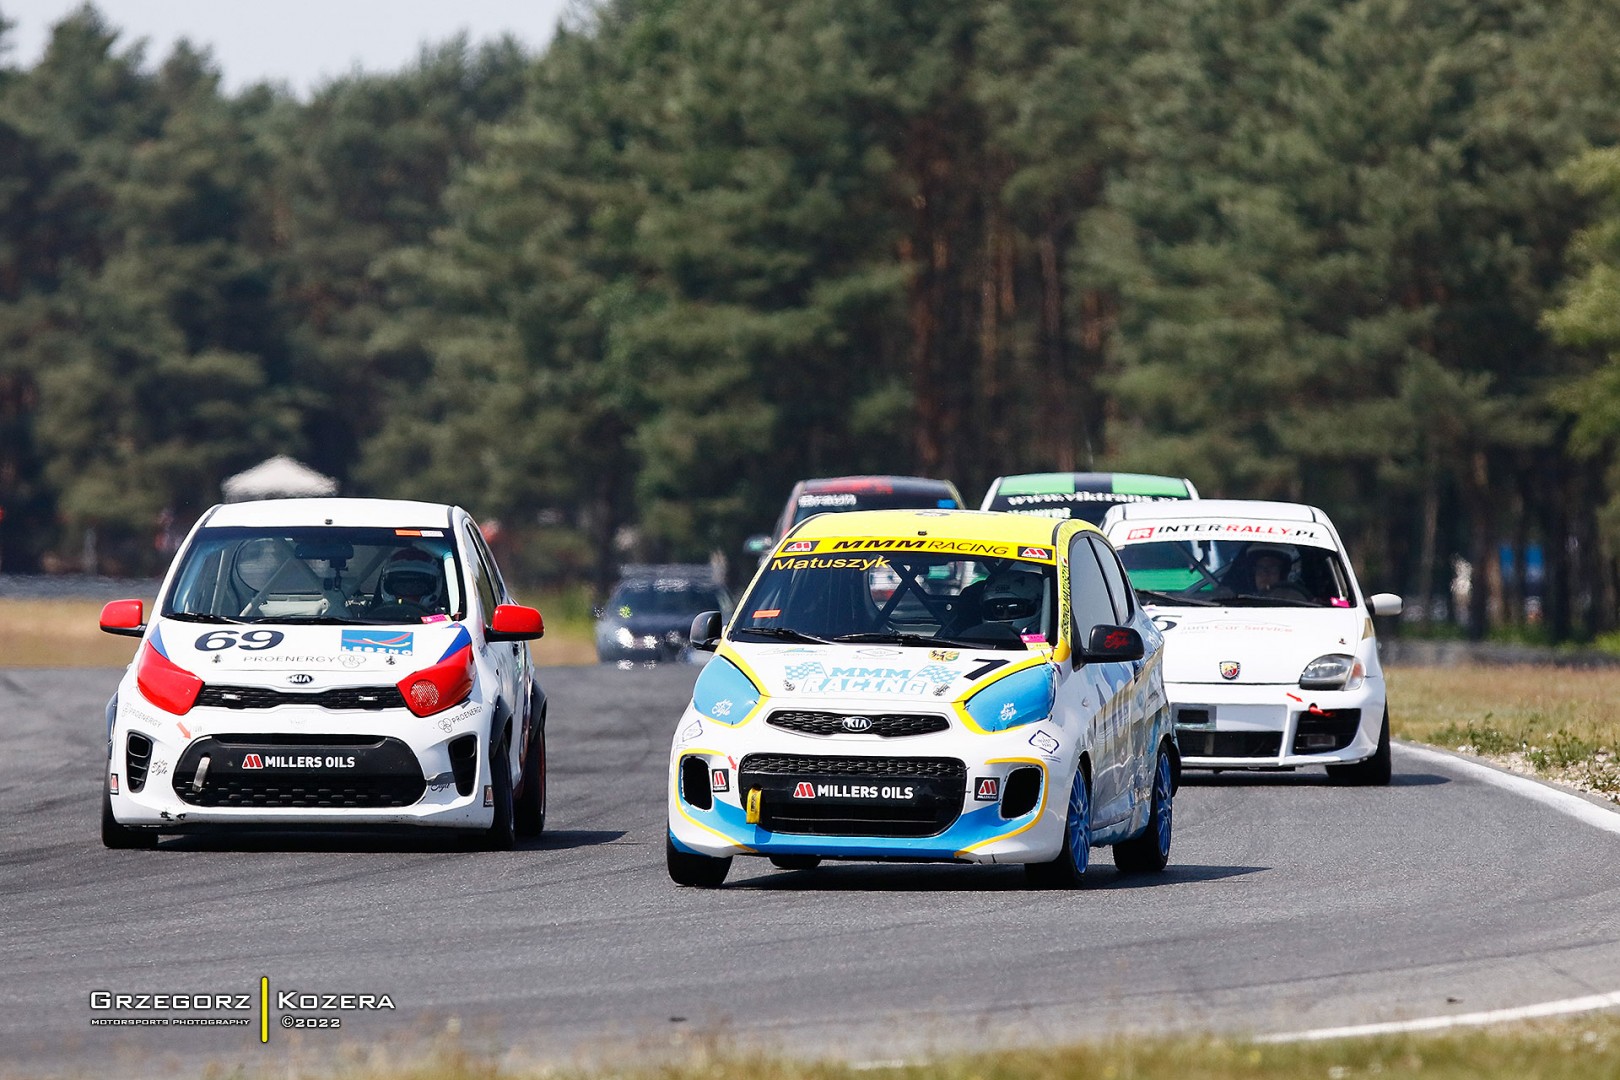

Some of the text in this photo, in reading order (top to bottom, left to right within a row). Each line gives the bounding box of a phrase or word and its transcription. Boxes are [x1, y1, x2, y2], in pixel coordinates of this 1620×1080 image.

[832, 540, 1008, 555] MMM RACING
[770, 556, 891, 571] Matuszyk
[194, 629, 285, 652] 69
[243, 655, 336, 664] PROENERGY
[829, 667, 911, 679] MMM
[963, 658, 1011, 681] 7
[289, 674, 311, 684] KIA
[800, 677, 928, 696] RACING
[451, 706, 484, 725] PROENERGY
[845, 718, 869, 729] KIA
[265, 755, 356, 769] MILLERS OILS
[817, 784, 914, 800] MILLERS OILS
